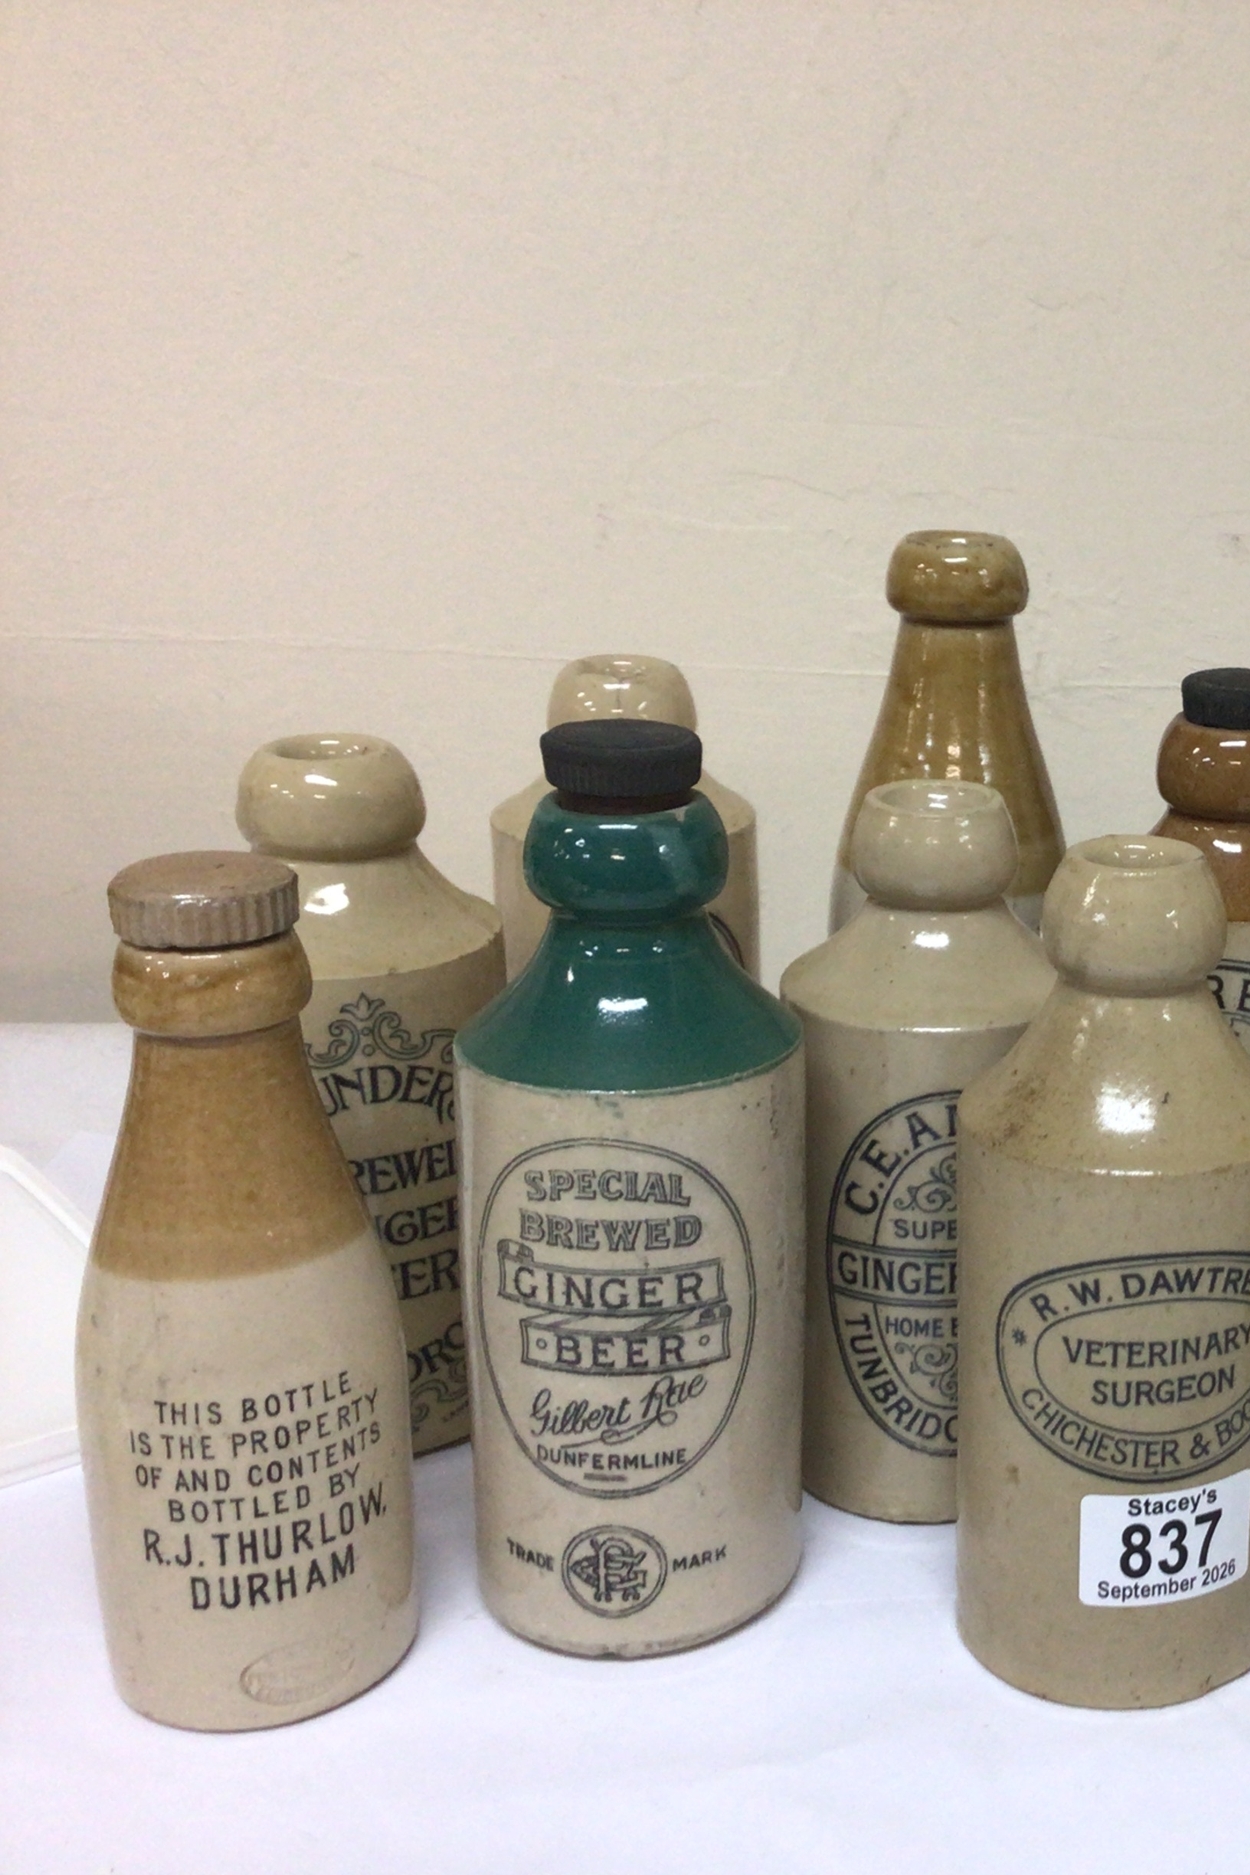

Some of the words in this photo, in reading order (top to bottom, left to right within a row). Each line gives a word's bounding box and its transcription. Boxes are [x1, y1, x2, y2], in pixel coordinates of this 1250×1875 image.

[524, 1169, 692, 1207] SPECIAL
[519, 1208, 703, 1251] BREWED
[513, 1265, 704, 1310] GINGER
[885, 1315, 944, 1338] HOME
[555, 1333, 686, 1369] BEER
[154, 1400, 223, 1426] THIS
[241, 1370, 352, 1423] BOTTLE
[1090, 1364, 1236, 1407] SURGEON
[130, 1430, 152, 1457] IS
[161, 1433, 216, 1462] THE
[230, 1388, 379, 1459] PROPERTY
[530, 1388, 632, 1437] Gilbert
[1021, 1387, 1182, 1469] CHICHESTER
[1189, 1432, 1212, 1460] &
[134, 1462, 164, 1490] OF
[174, 1466, 231, 1493] AND
[246, 1421, 382, 1489] CONTENTS
[536, 1444, 688, 1470] DUNFERMLINE
[167, 1484, 311, 1524] BOTTLED
[329, 1462, 361, 1500] BY
[1127, 1488, 1218, 1517] Stacey's
[506, 1536, 555, 1572] TRADE
[672, 1544, 728, 1572] MARK
[1120, 1508, 1223, 1579] 837
[190, 1543, 356, 1611] DURHAM
[1097, 1576, 1197, 1603] September
[1201, 1558, 1237, 1588] 2026
